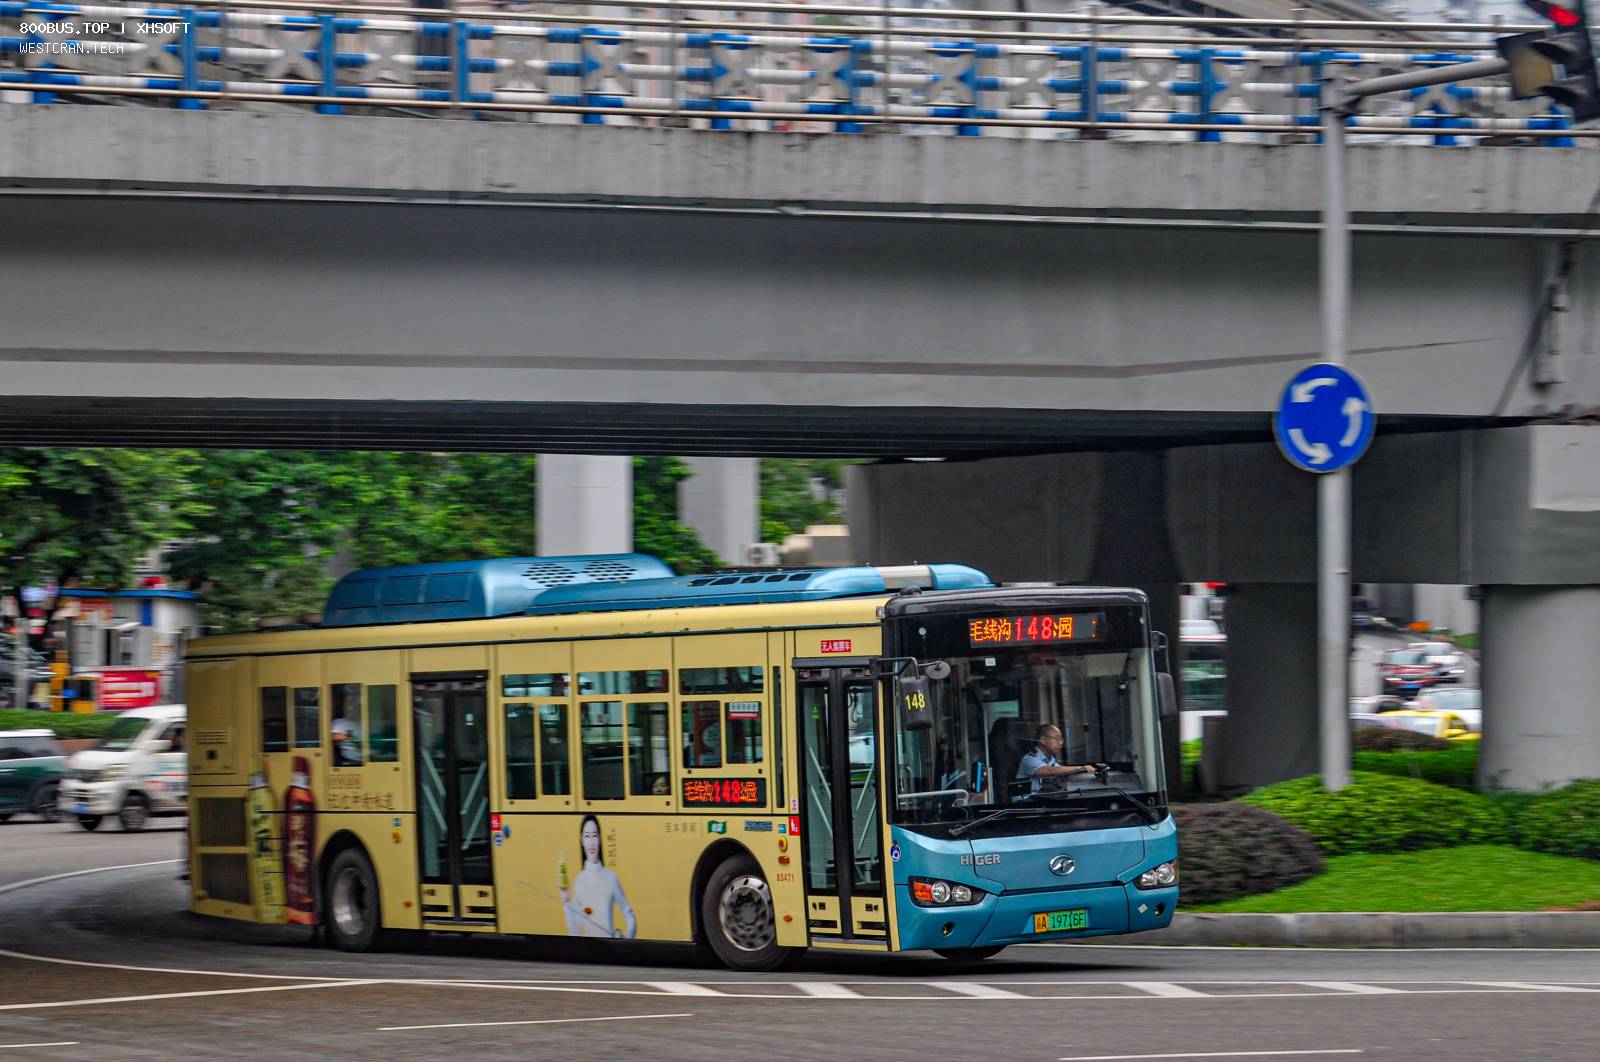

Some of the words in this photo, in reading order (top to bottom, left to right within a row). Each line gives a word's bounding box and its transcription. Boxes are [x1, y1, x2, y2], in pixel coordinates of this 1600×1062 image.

[970, 618, 1012, 641] 毛线沟
[1014, 616, 1053, 641] 148
[905, 692, 926, 710] 148
[713, 780, 741, 803] 148
[960, 853, 1001, 866] HIGER
